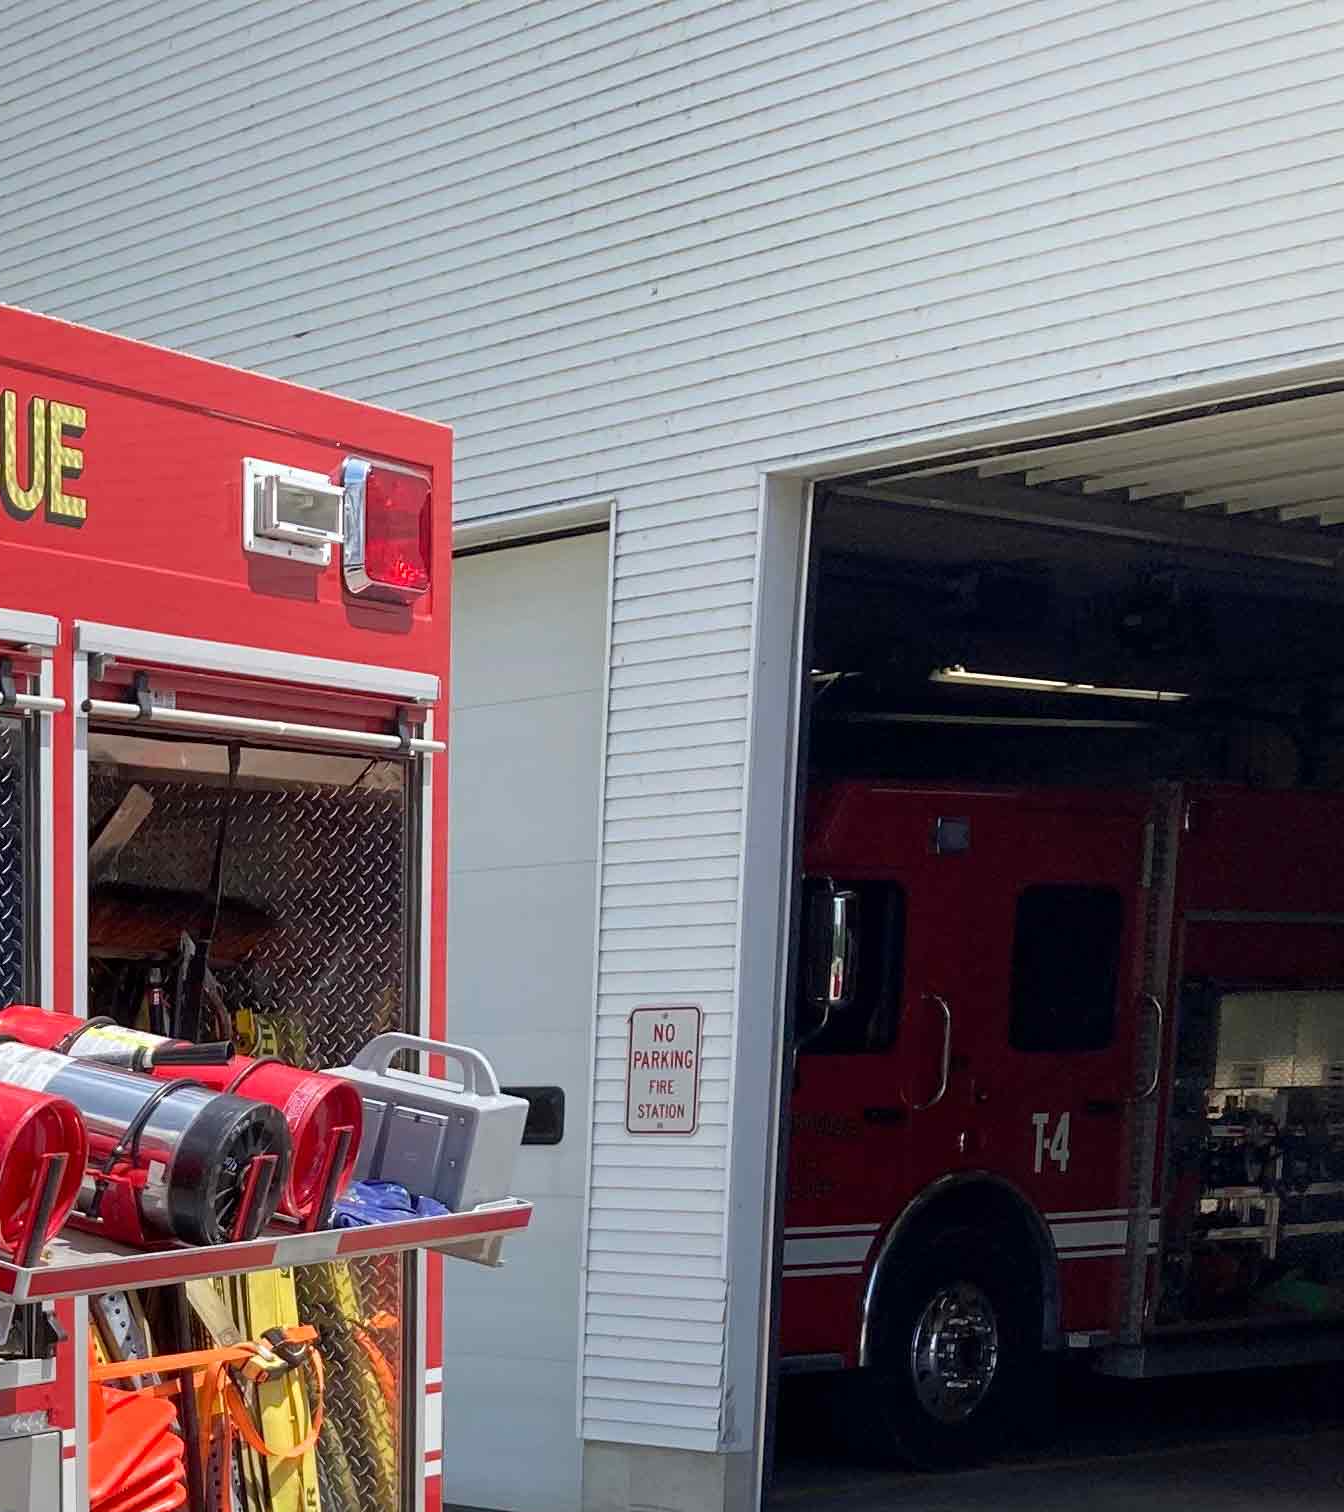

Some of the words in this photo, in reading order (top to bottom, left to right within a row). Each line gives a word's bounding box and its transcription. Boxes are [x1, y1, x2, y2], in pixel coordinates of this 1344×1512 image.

[653, 1023, 676, 1043] NO
[633, 1049, 694, 1070] PARKING
[648, 1079, 675, 1095] FIRE
[637, 1103, 685, 1119] STATION
